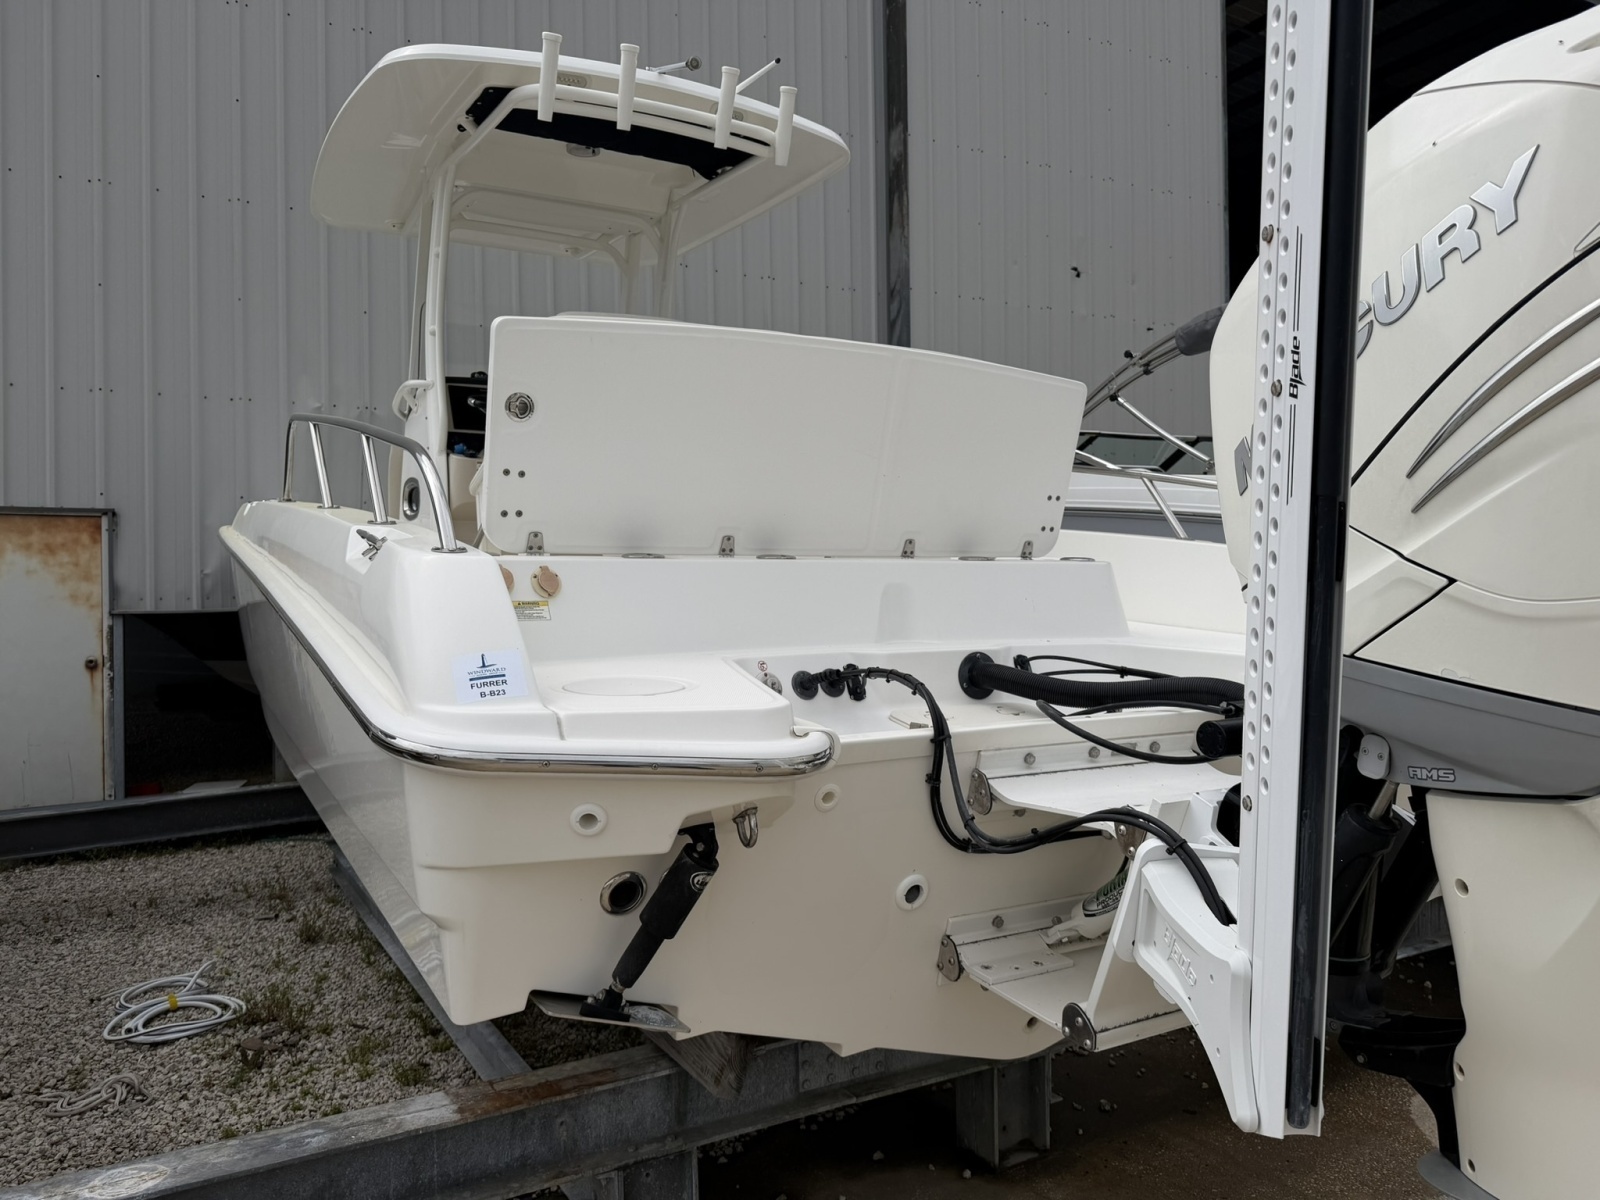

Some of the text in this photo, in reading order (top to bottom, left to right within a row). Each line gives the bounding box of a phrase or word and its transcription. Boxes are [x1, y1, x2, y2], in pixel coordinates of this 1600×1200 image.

[1289, 335, 1307, 400] Blade
[467, 667, 507, 676] WINDWARD
[470, 679, 508, 690] FURRER
[480, 689, 506, 698] B-B23
[1407, 765, 1456, 783] AMS
